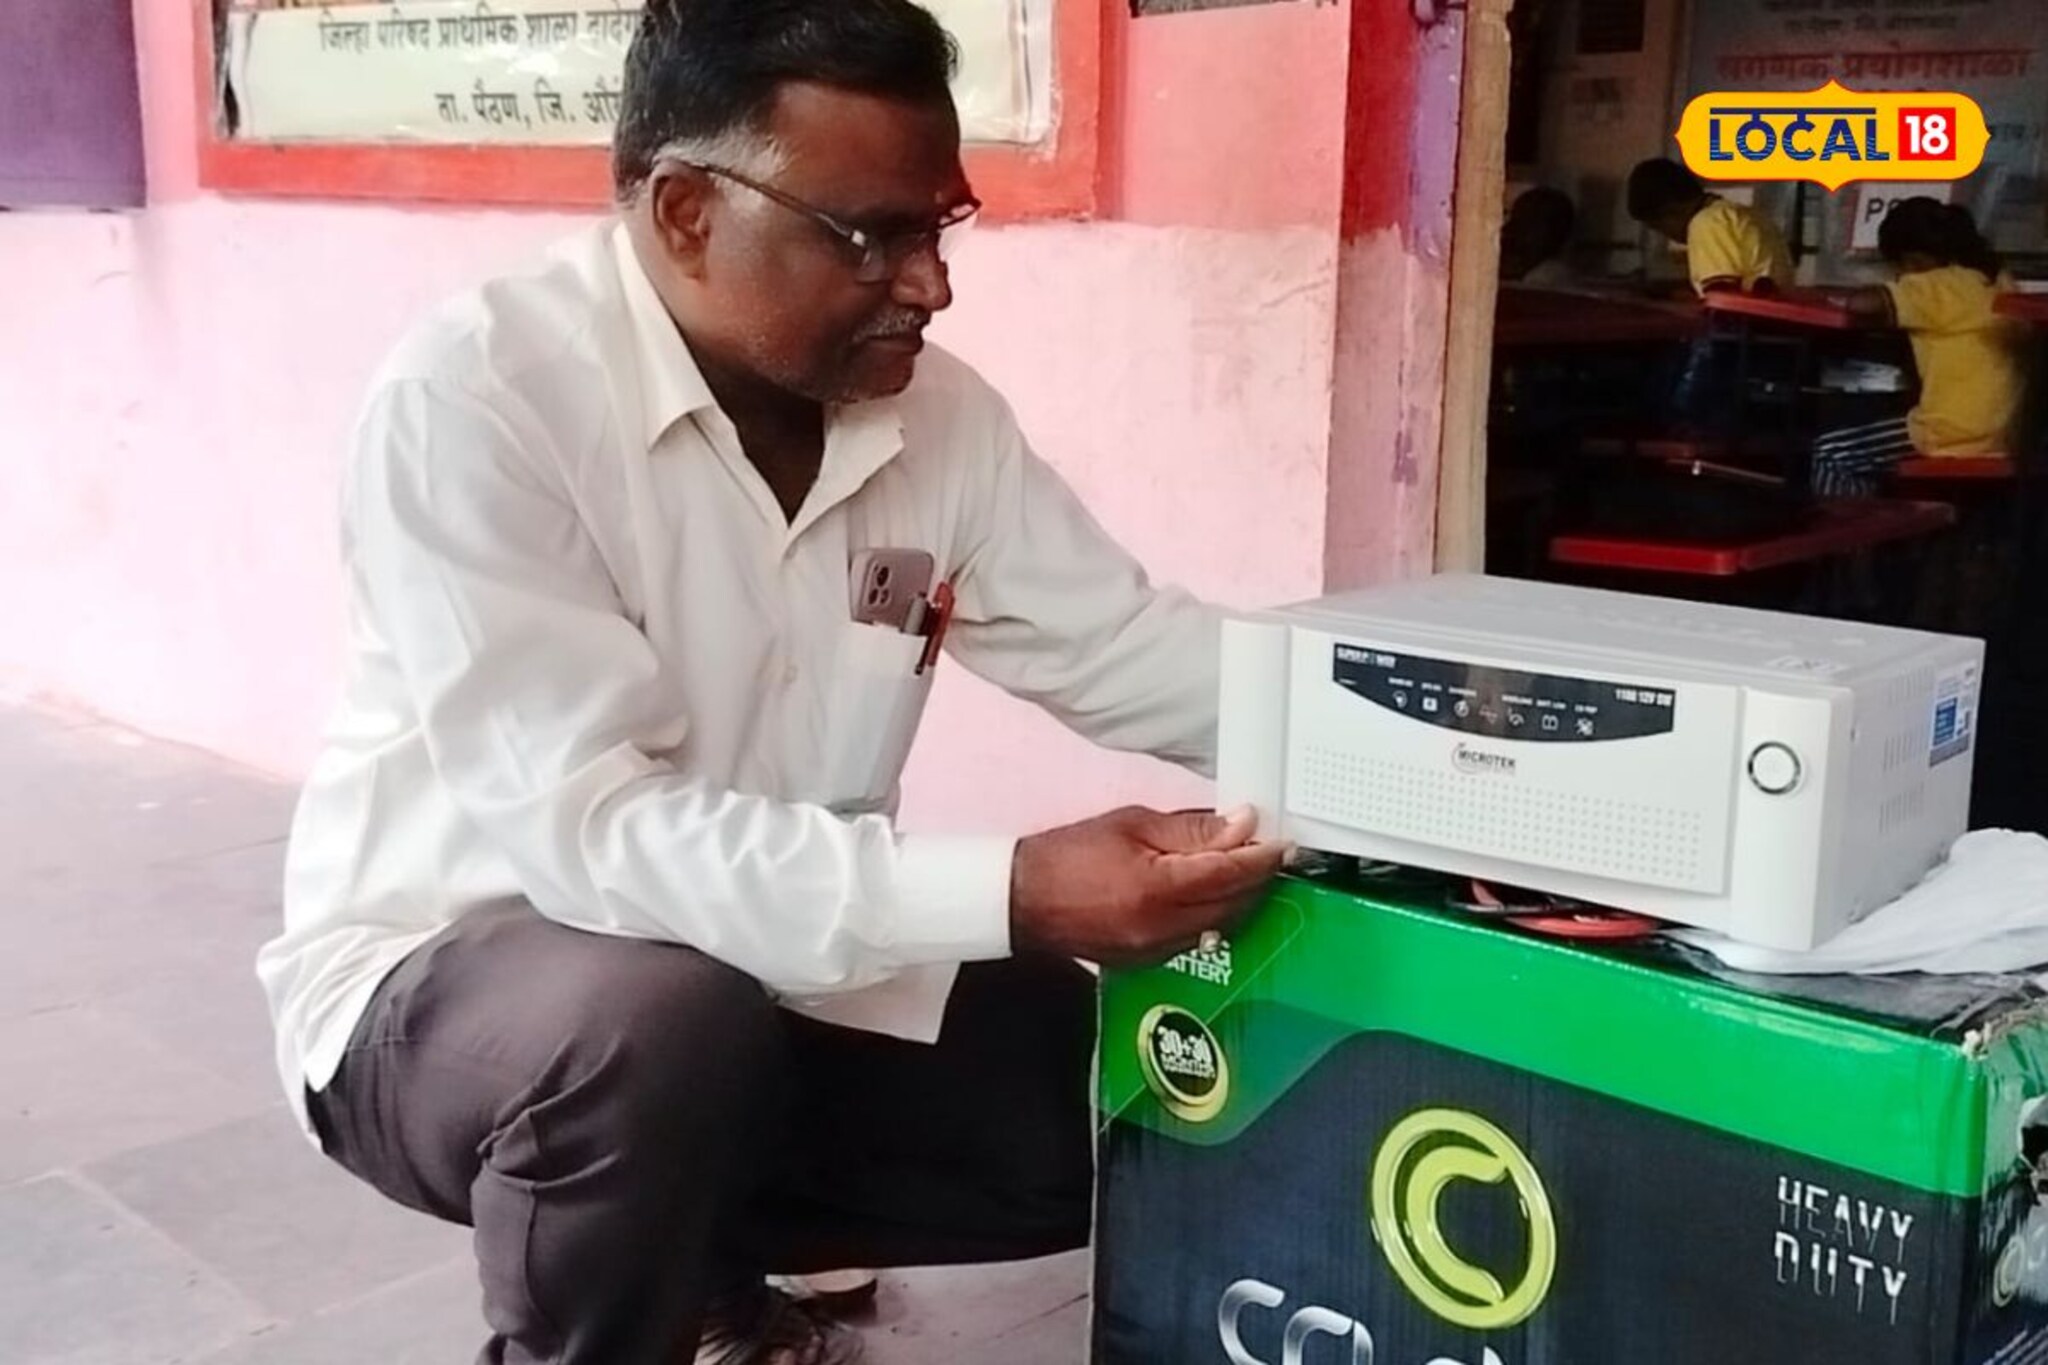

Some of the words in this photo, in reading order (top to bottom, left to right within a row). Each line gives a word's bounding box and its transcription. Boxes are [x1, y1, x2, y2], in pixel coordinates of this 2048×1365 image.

[437, 1, 518, 50] प्राथमिक
[1457, 750, 1516, 768] MICROTEK
[1162, 953, 1233, 986] ATTERY
[1777, 1175, 1914, 1263] HEAVY
[1774, 1231, 1907, 1326] DUTY
